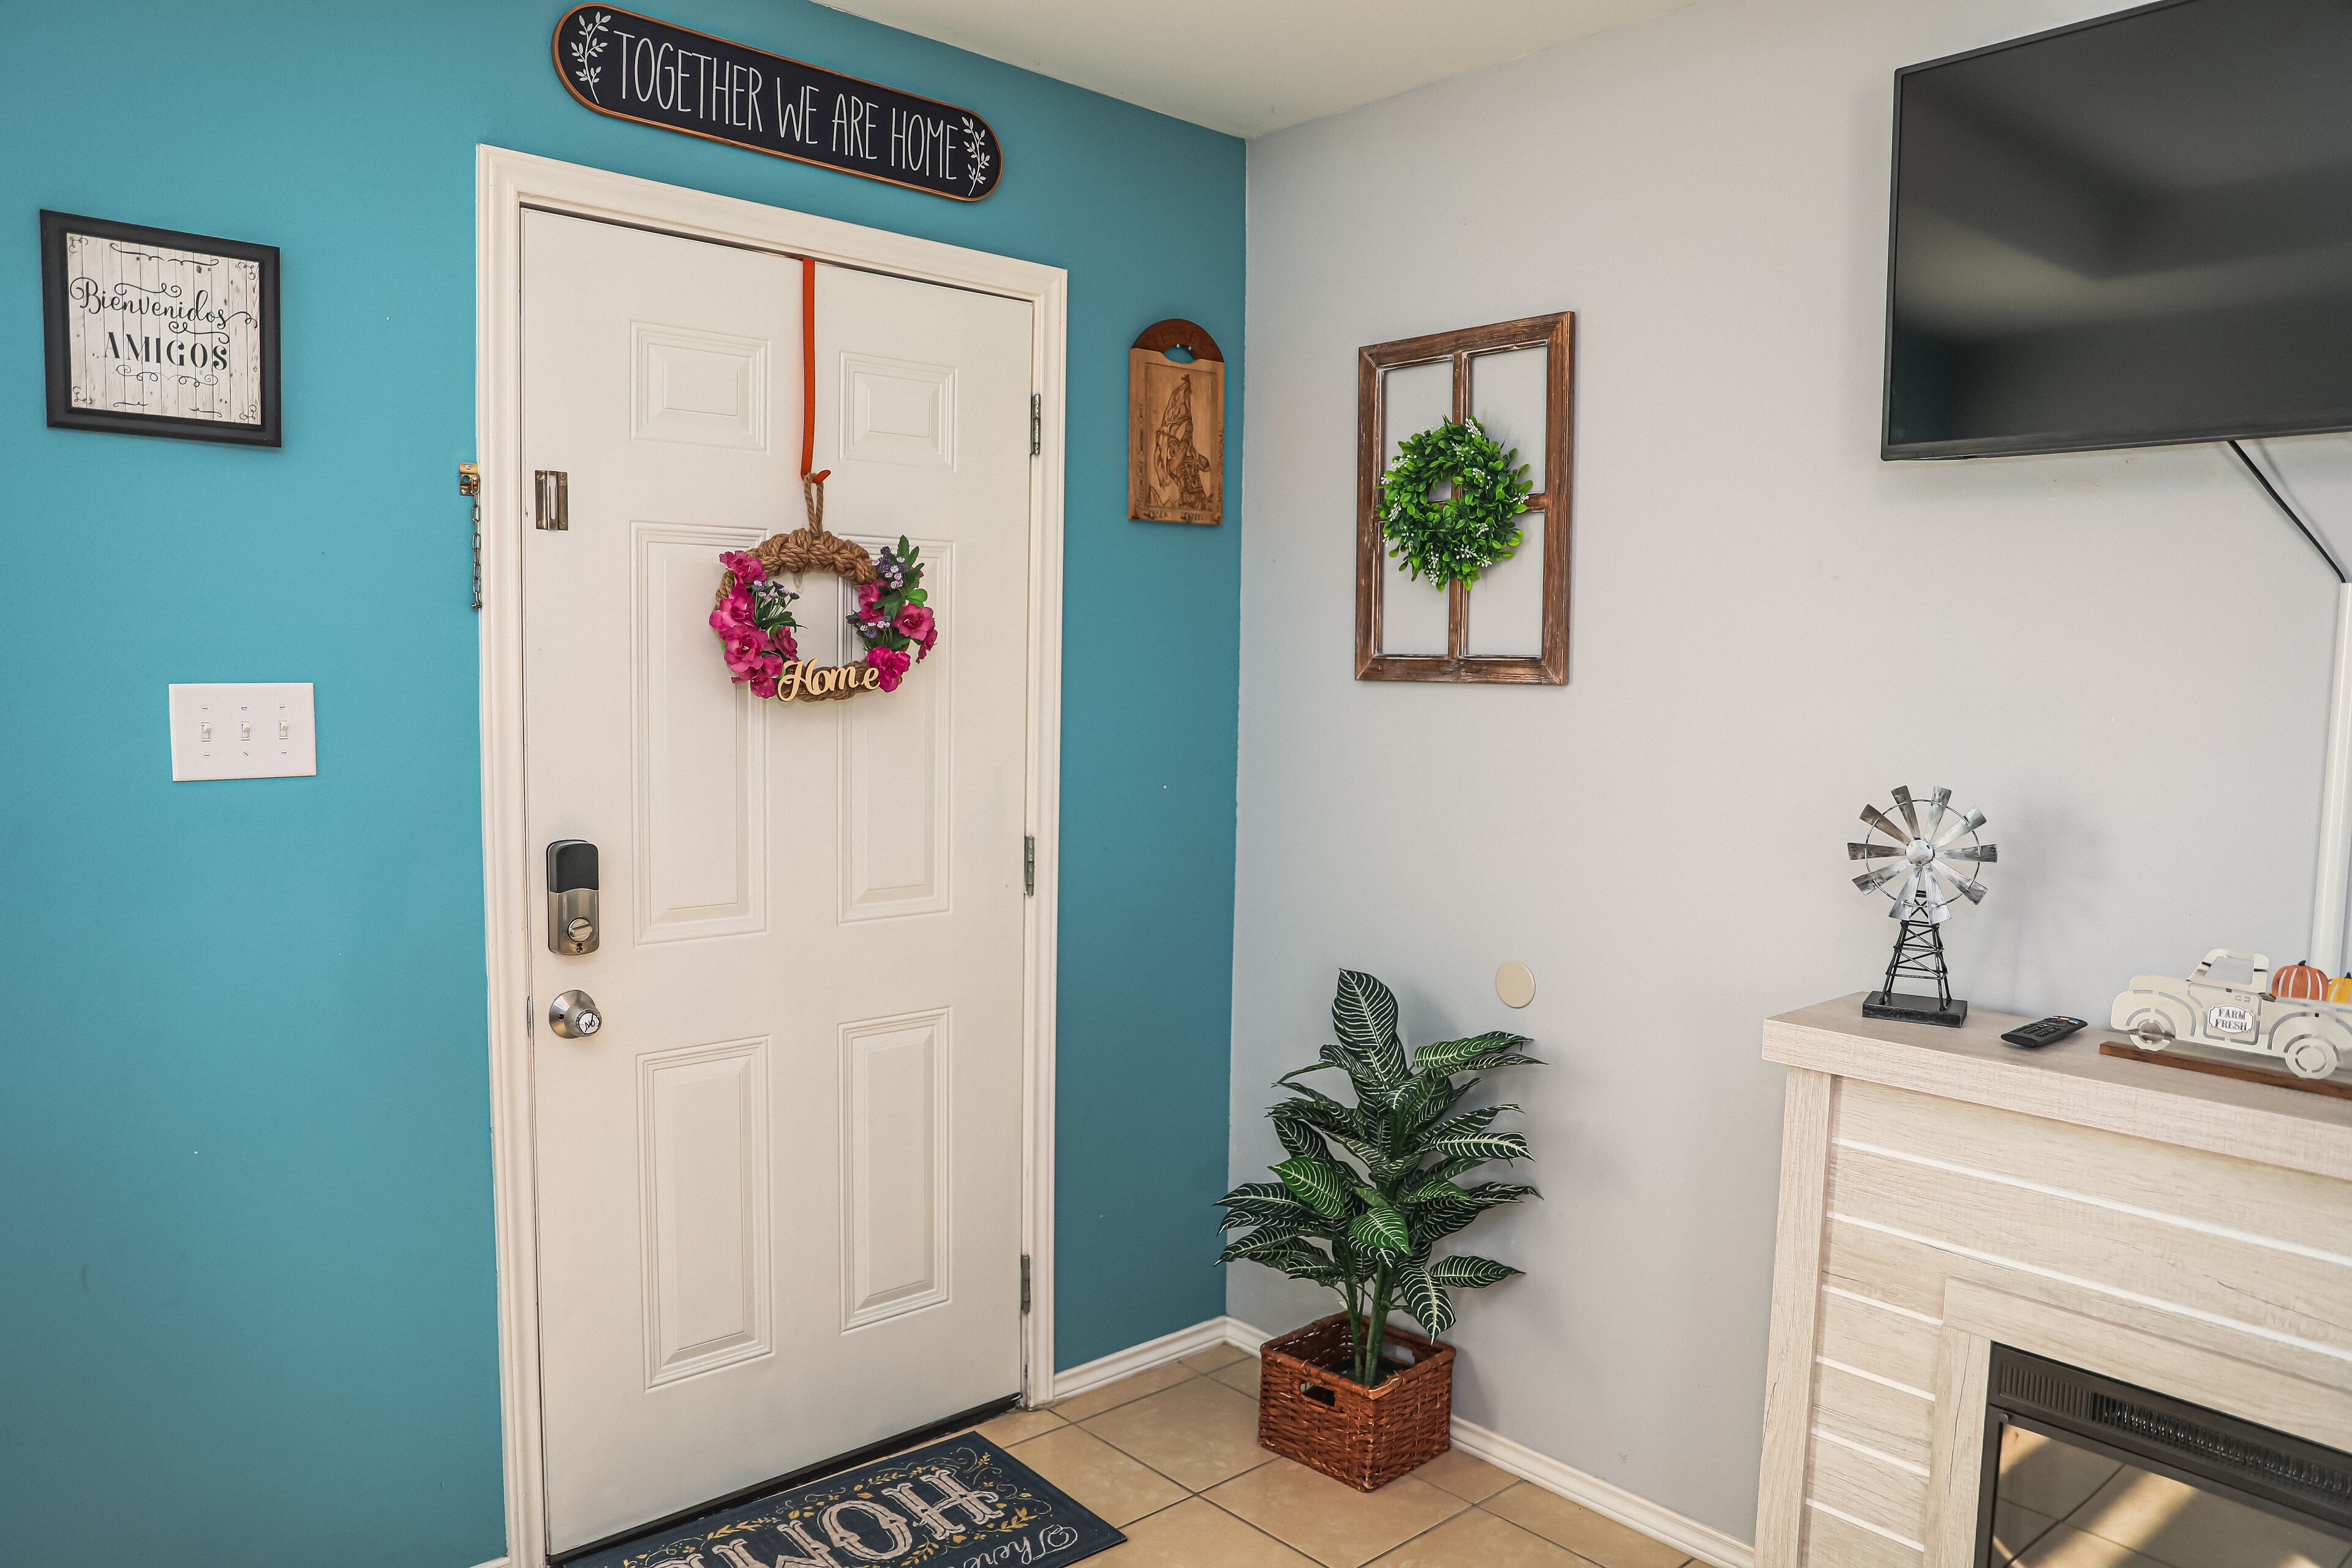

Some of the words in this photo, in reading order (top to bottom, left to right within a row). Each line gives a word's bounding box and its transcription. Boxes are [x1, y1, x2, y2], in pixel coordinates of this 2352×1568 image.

[613, 31, 763, 132] TOGETHER
[777, 77, 819, 145] WE
[832, 94, 880, 160] ARE
[891, 107, 958, 180] HOME
[70, 277, 257, 329] Bienvenidos
[104, 331, 227, 371] AMIGOS
[777, 658, 880, 702] Home
[2215, 1019, 2247, 1031] FRESH
[2218, 1008, 2245, 1020] FARM
[650, 1469, 1003, 1568] HOM
